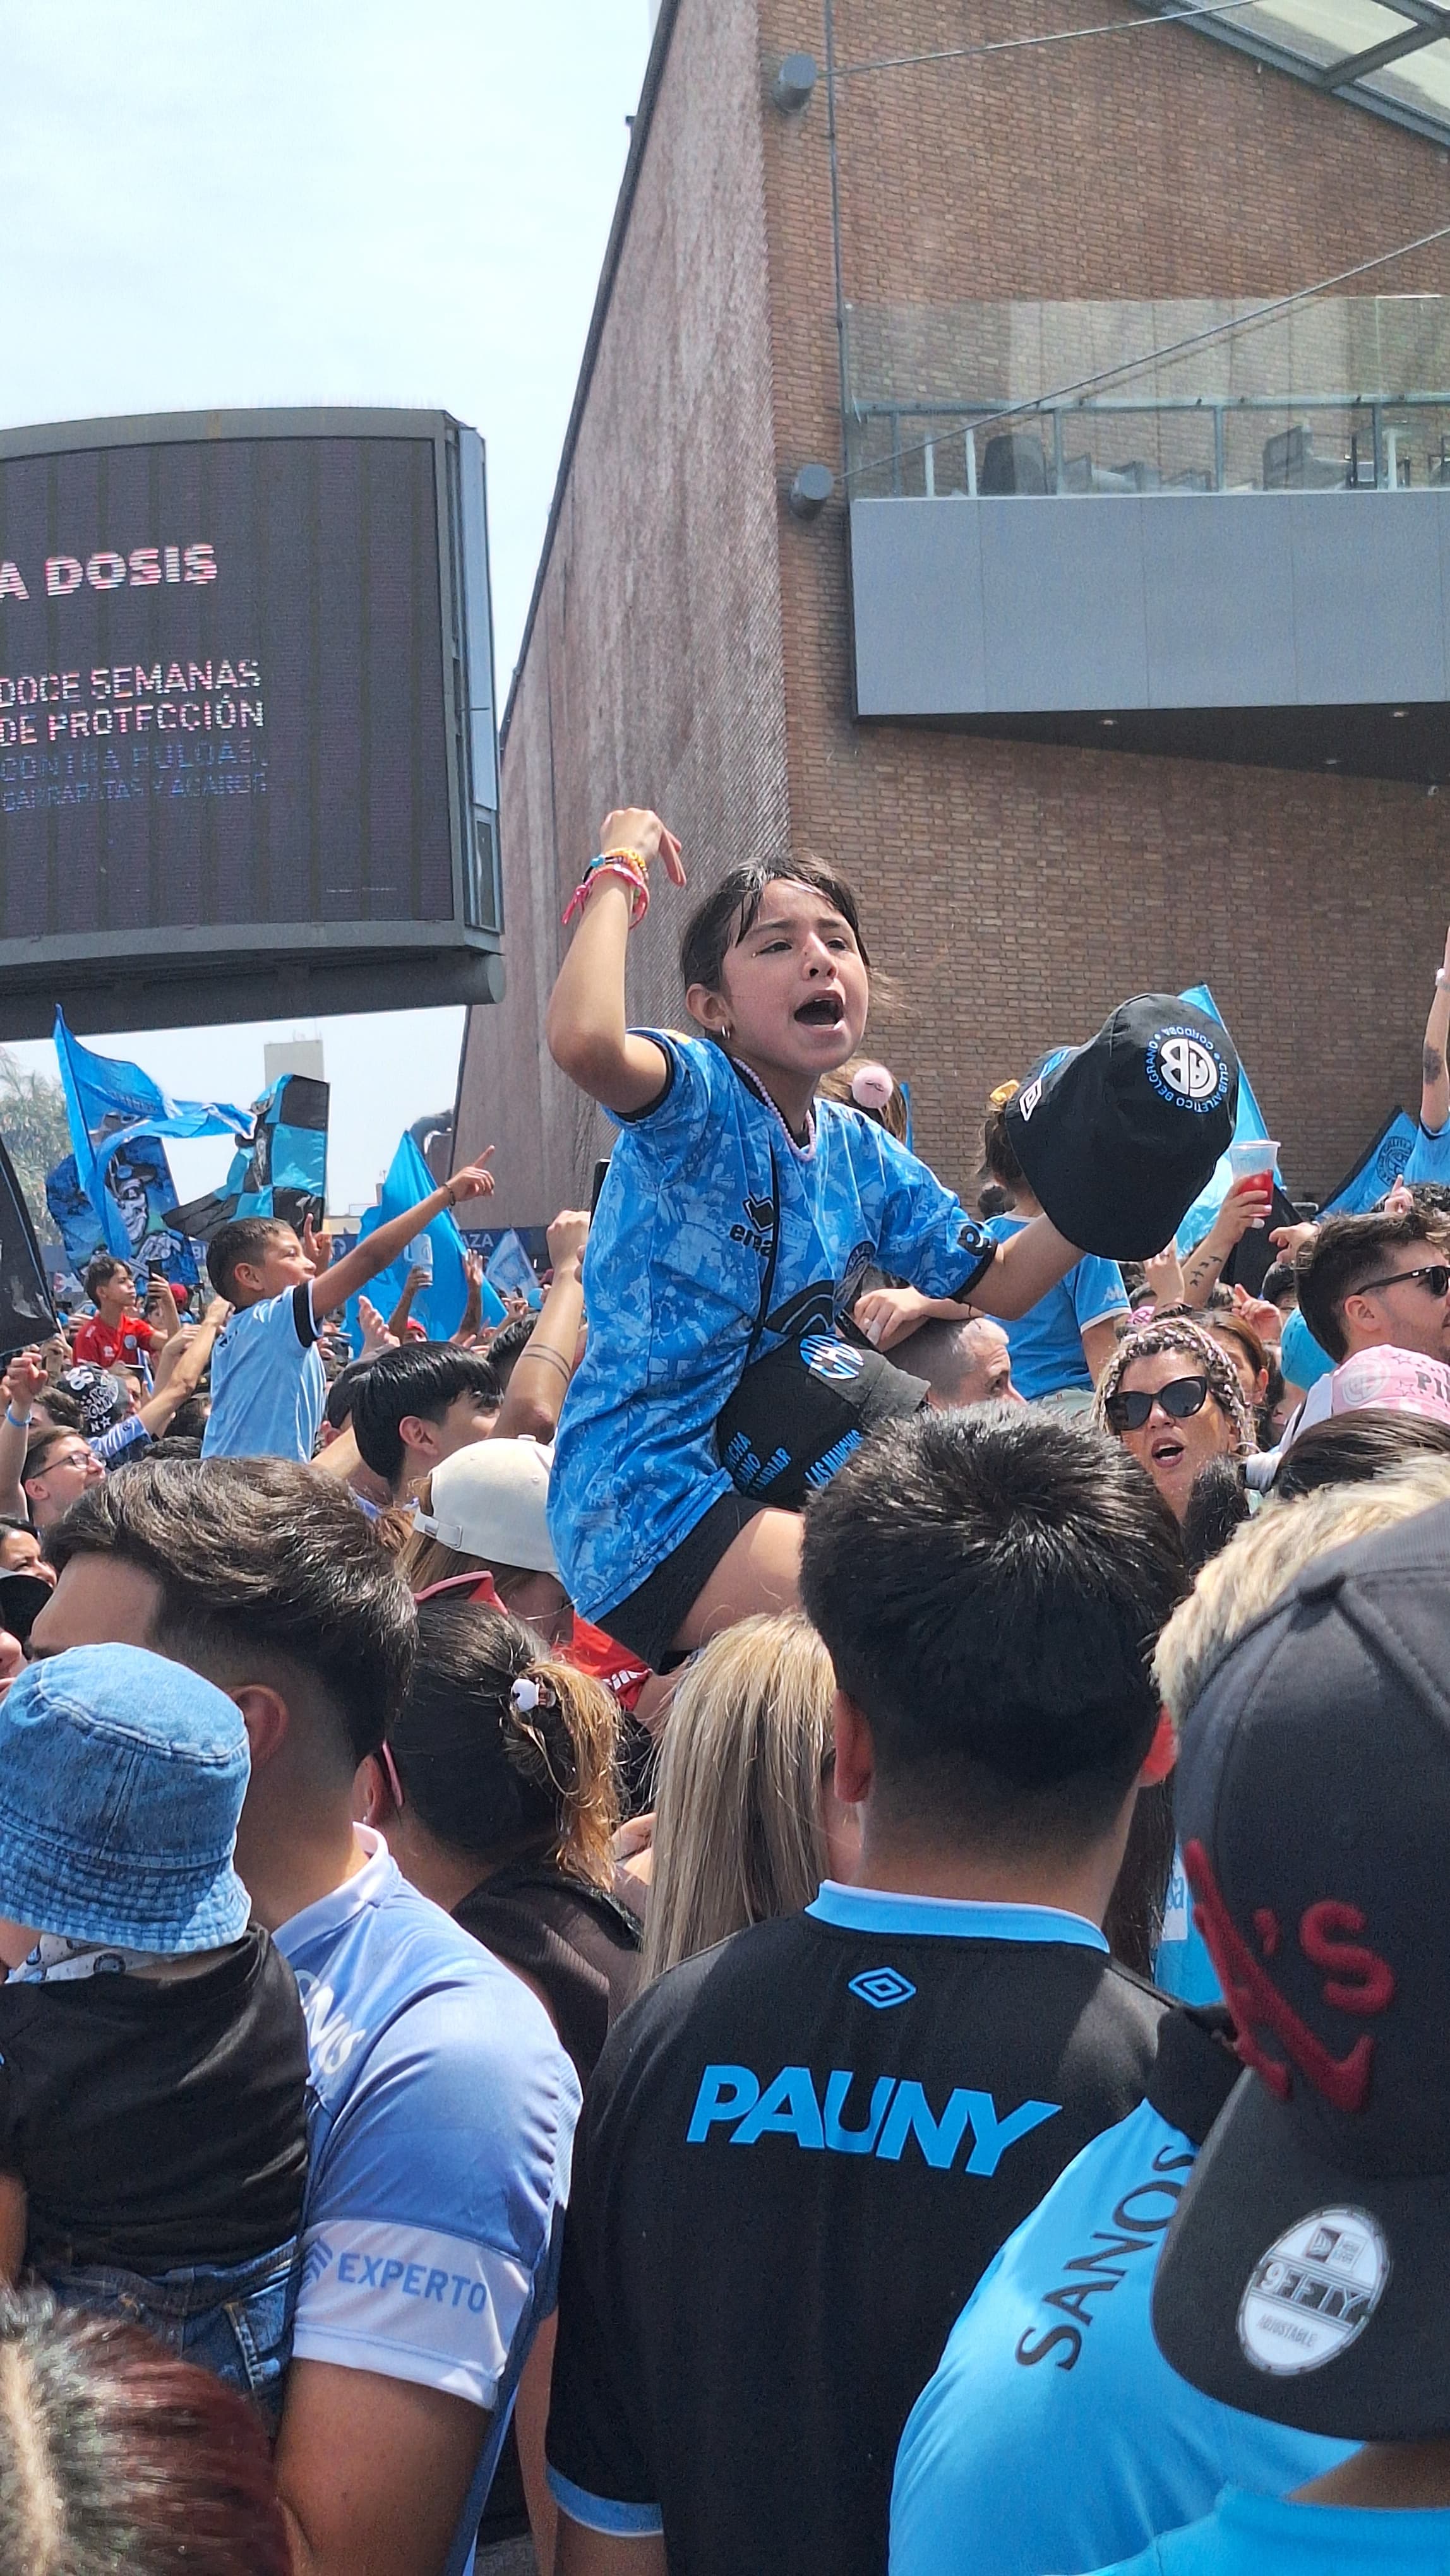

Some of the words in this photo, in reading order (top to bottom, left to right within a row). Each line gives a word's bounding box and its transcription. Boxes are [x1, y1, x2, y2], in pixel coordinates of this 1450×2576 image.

[44, 544, 218, 597] DOSIS
[90, 659, 261, 701] SEMANAS
[0, 714, 38, 748] DE
[48, 693, 265, 741] PROTECCIÓN
[1146, 1041, 1175, 1102] BELGRANO
[686, 2064, 1063, 2177] PAUNY
[338, 2251, 488, 2313] EXPERTO
